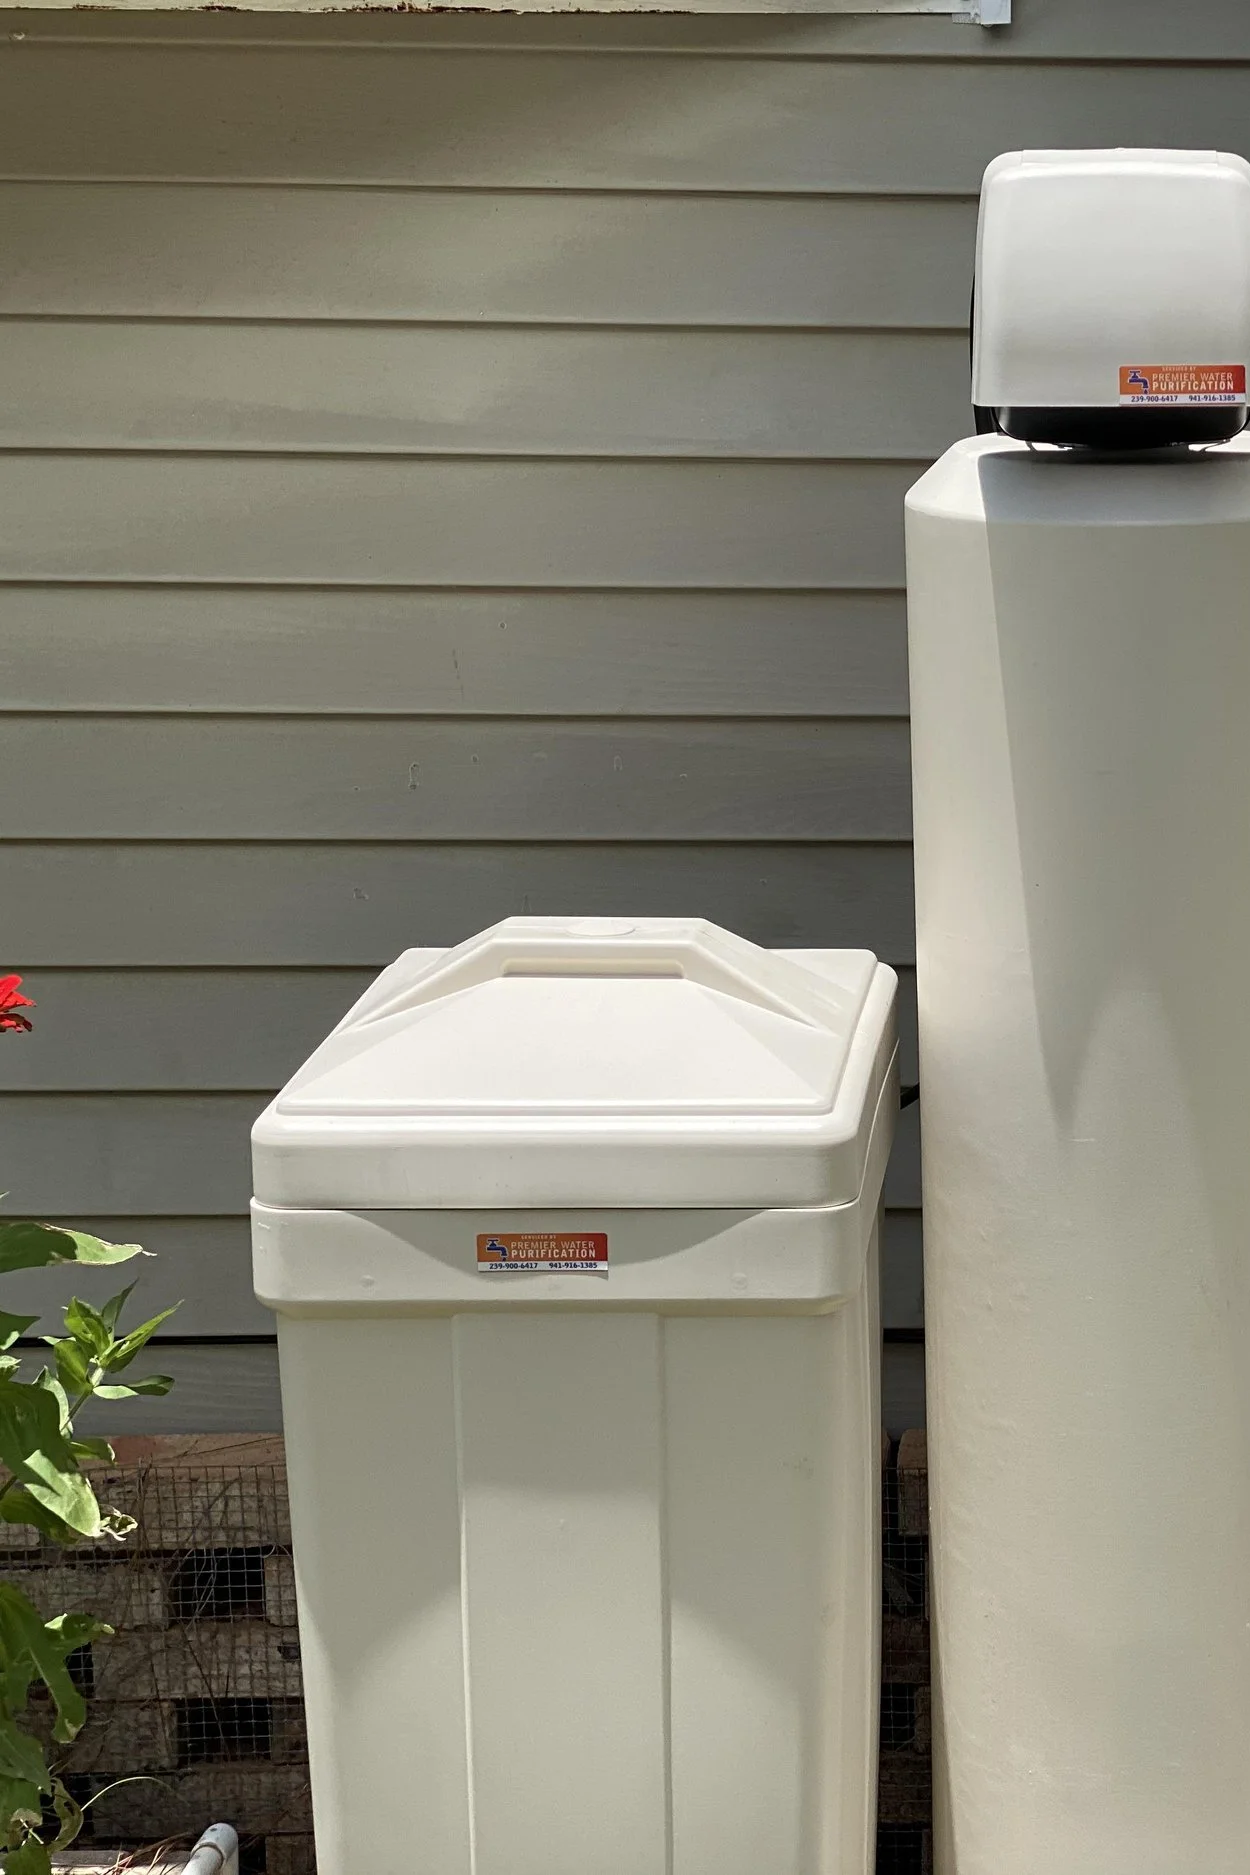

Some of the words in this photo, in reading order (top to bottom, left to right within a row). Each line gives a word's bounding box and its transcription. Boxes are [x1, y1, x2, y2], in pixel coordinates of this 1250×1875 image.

[1152, 372, 1196, 381] PREMIER
[1200, 372, 1233, 381] WATER
[1152, 381, 1234, 391] PURIFICATION
[1188, 394, 1236, 402] 941-916-1385
[511, 1241, 557, 1249] PREMIER
[561, 1241, 595, 1249] WATER
[511, 1249, 596, 1258] PURIFICATION
